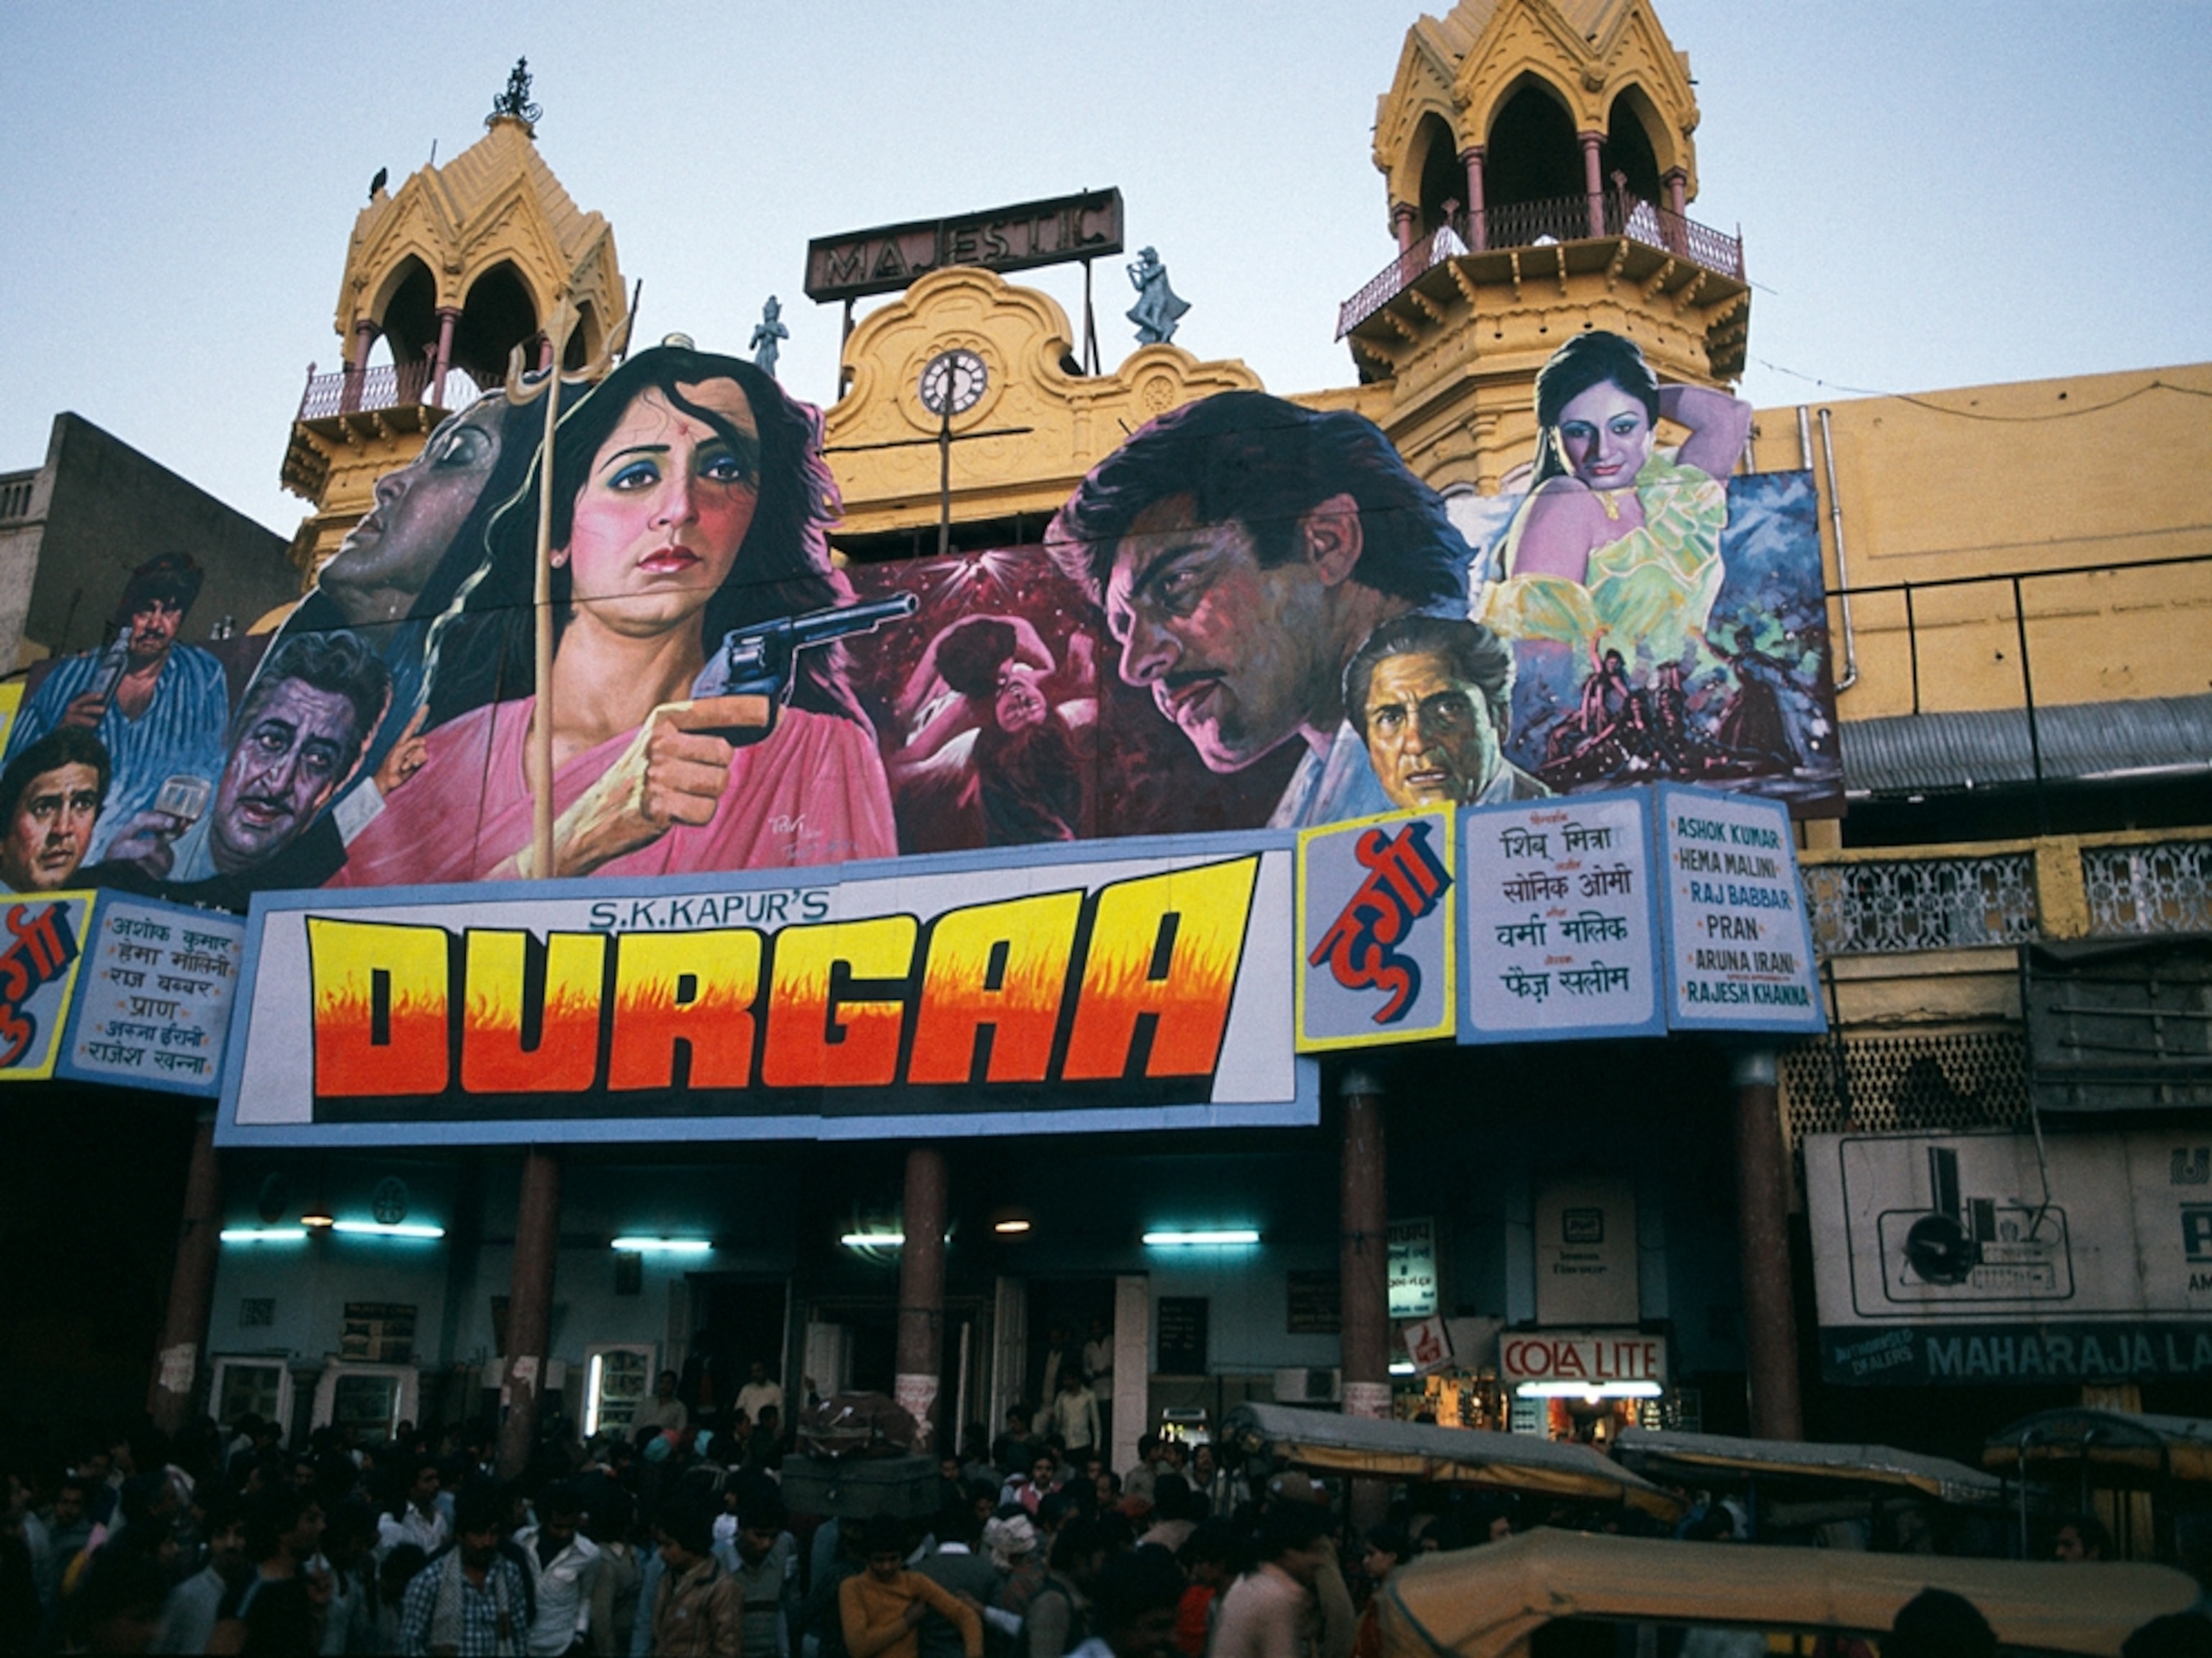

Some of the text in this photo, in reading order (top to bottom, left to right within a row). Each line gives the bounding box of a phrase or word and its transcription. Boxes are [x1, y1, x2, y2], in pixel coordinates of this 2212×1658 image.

[825, 202, 1106, 287] MAJESTIC
[1560, 822, 1611, 853] मित्रा
[1677, 815, 1781, 850] ASHOK KUMAR
[1679, 846, 1777, 879] HEMA MALINI
[1502, 871, 1569, 904] सोनिक
[1578, 862, 1632, 898] ओमी
[1691, 880, 1793, 911] RAJ BABBAR
[589, 887, 830, 931] S.K.KAPUR'S
[1308, 823, 1452, 1025] दुर्गा
[112, 916, 232, 952] अशोक कुमार
[1496, 910, 1628, 949] वर्मा मलिक
[1707, 914, 1759, 941] PRAN
[118, 937, 230, 977] हेमा मालिनी
[1696, 949, 1794, 974] ARUNA IRANI
[109, 967, 146, 988] राज
[305, 854, 1262, 1121] DURGAA
[1558, 959, 1630, 997] सलीम
[1687, 981, 1810, 1006] RAJESH KHANNA
[129, 995, 181, 1020] प्राण
[89, 1039, 208, 1075] राजेश खन्ना
[1505, 1340, 1658, 1379] COLA LITE
[1851, 1345, 1914, 1376] DEALERS
[1925, 1332, 2157, 1376] MAHARAJA
